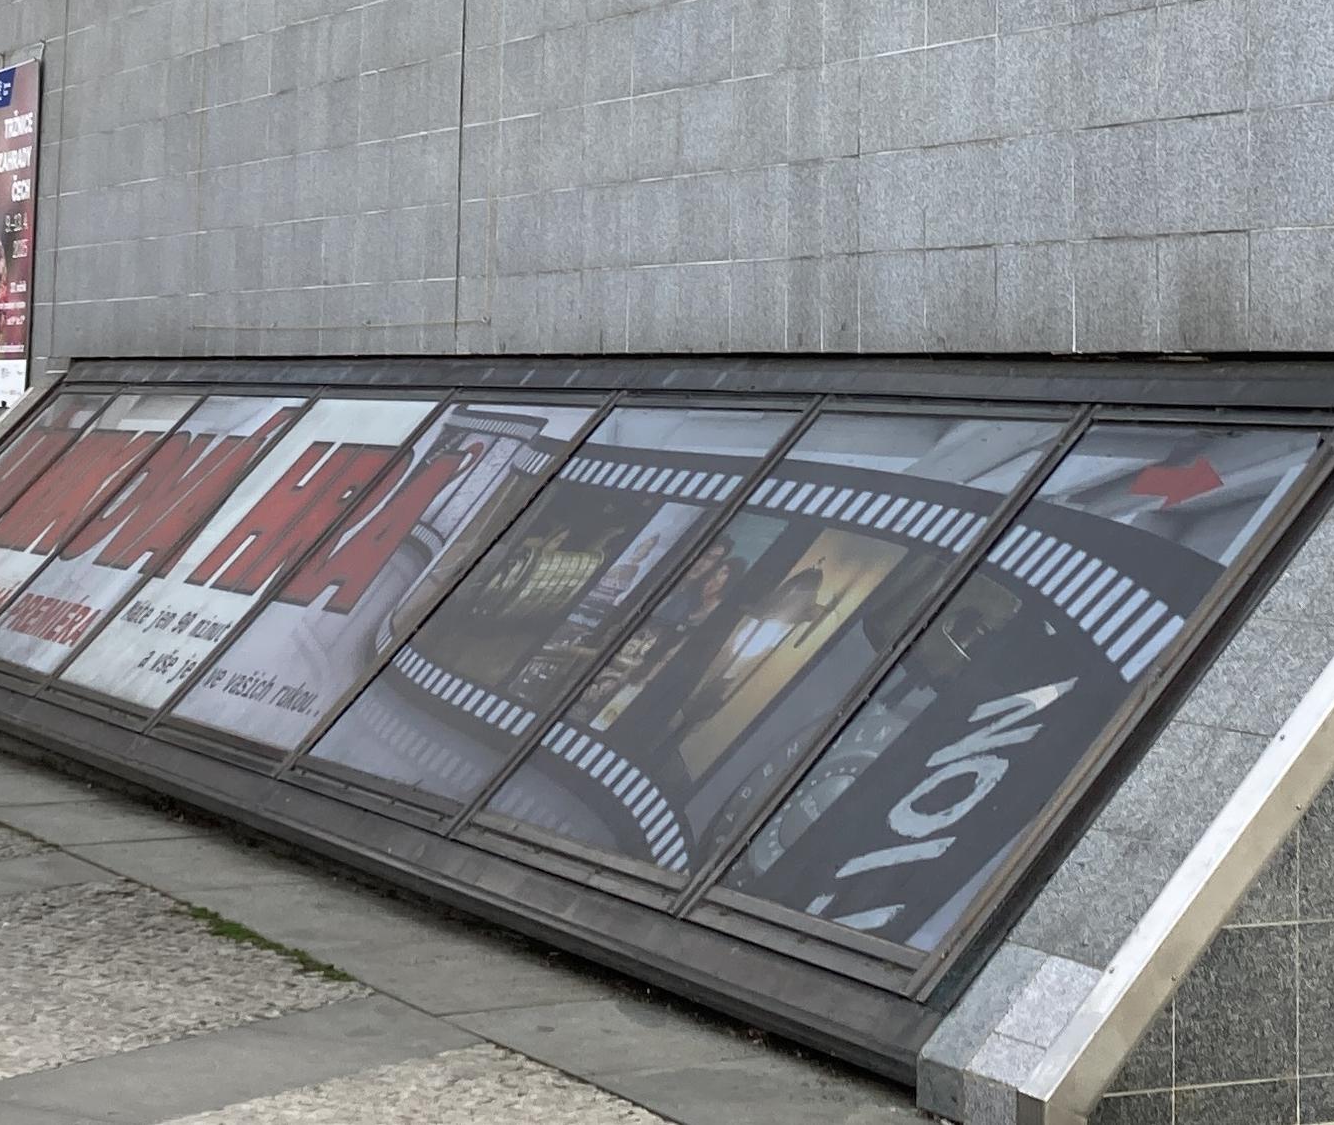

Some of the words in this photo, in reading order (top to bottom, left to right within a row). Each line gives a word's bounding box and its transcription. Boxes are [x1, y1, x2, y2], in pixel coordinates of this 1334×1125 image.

[11, 175, 31, 202] ČECH
[185, 441, 470, 615] HRA
[9, 595, 101, 647] PREMIÉRA
[142, 604, 178, 633] jen
[171, 611, 197, 634] 90
[187, 615, 232, 643] minut
[137, 650, 156, 668] a
[151, 649, 180, 674] vše
[166, 653, 199, 684] je
[202, 666, 227, 689] ve
[223, 669, 277, 701] vašich
